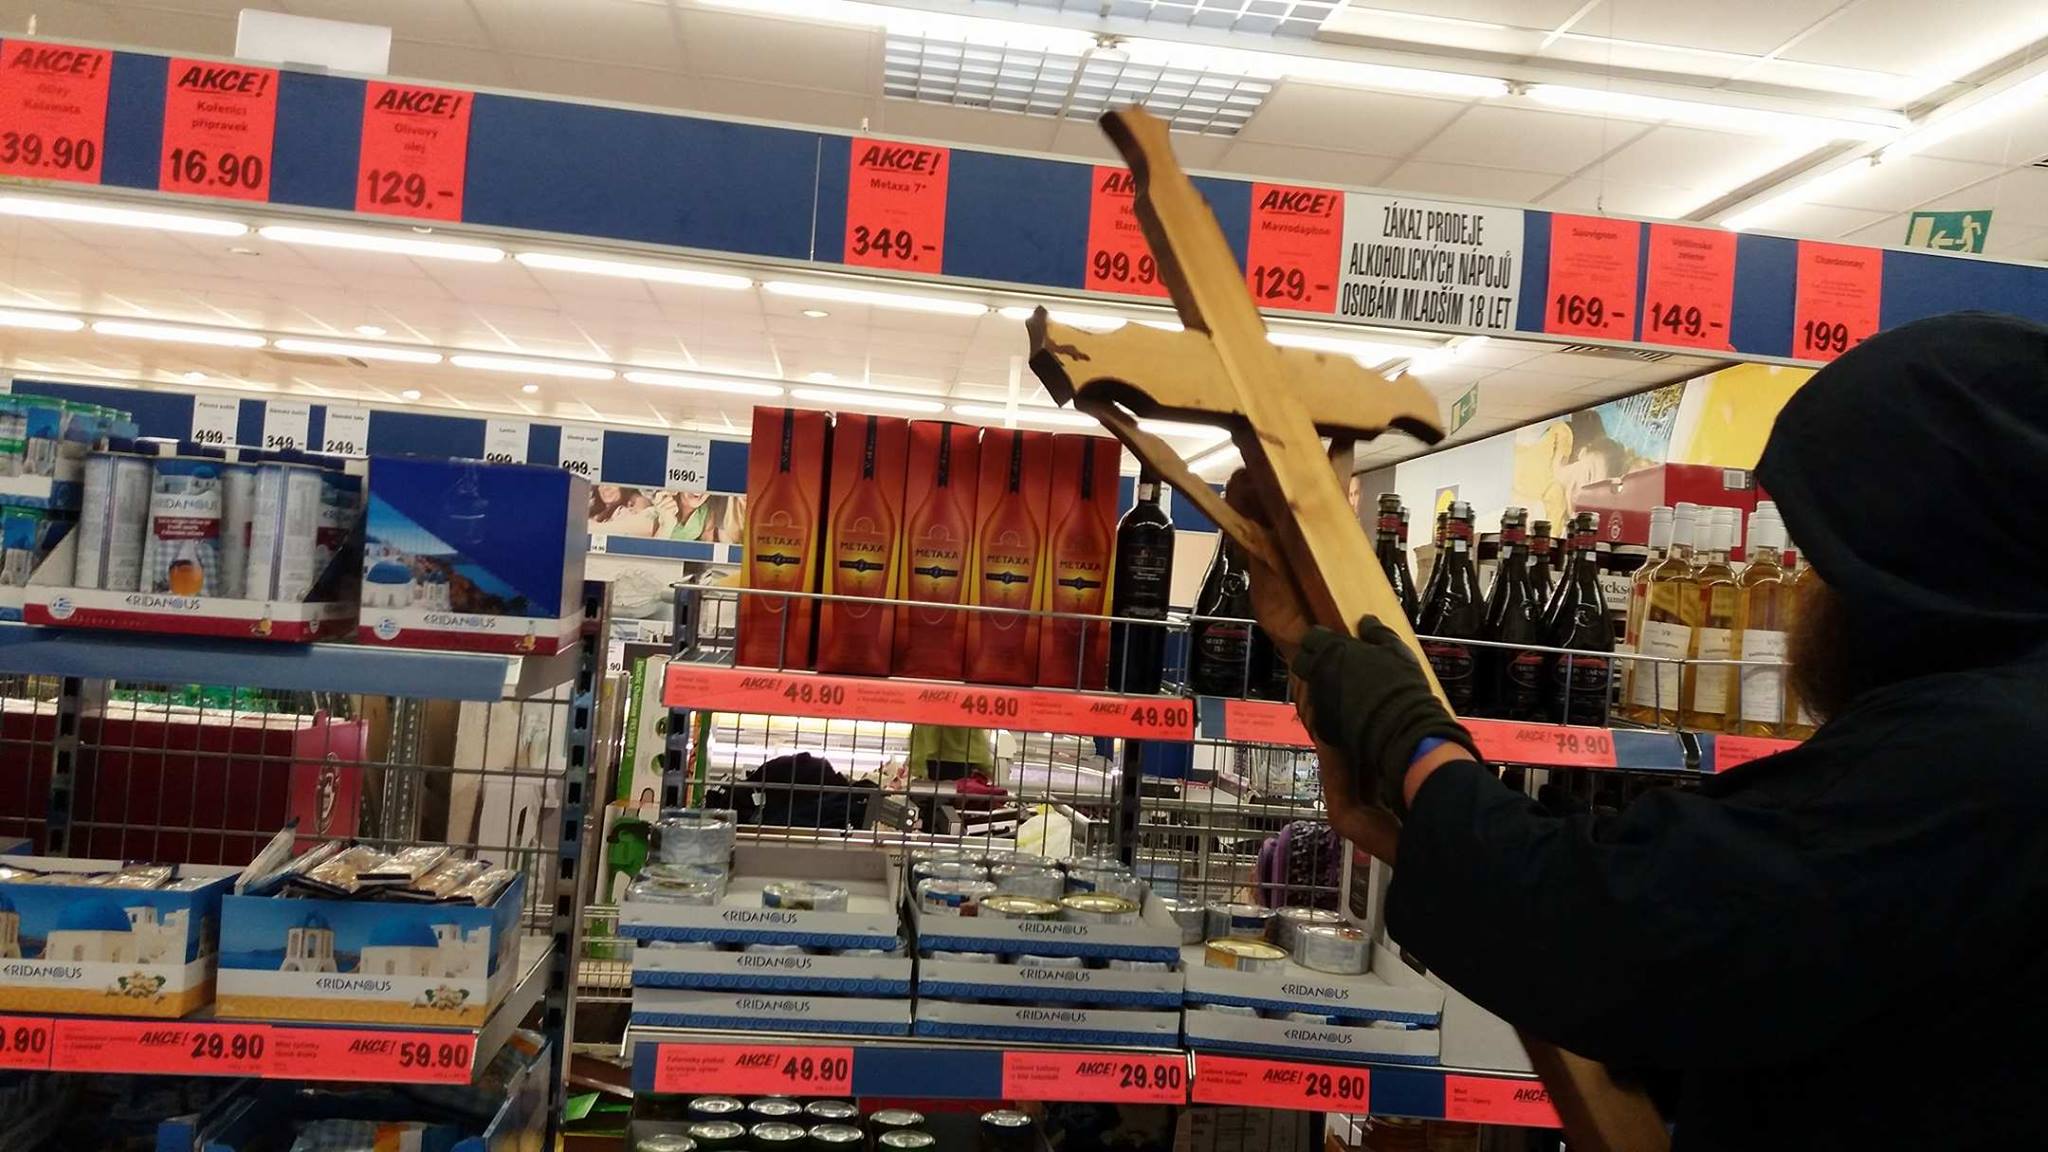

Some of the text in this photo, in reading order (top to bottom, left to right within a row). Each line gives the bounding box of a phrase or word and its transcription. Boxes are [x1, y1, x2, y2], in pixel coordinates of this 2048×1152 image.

[8, 47, 103, 79] AKCE!
[177, 66, 269, 98] AKCE!
[374, 89, 463, 120] AKCE!
[0, 131, 95, 172] 39.90
[859, 145, 941, 176] AKCE!
[170, 148, 263, 190] 16.90
[367, 169, 454, 209] 129.-
[869, 178, 910, 192] Metaxa
[1259, 190, 1337, 218] AKCE!
[1383, 201, 1484, 246] ZÁKAZ PRODEJE
[852, 225, 936, 261] 349.-
[1093, 250, 1168, 287] 99.9
[1349, 243, 1512, 290] ALKOHOLICKÝCH NÁPOJŮ
[1254, 265, 1330, 302] 129.-
[1342, 280, 1513, 329] OSOBÁM MLADŠÍM 18 LET
[1556, 293, 1626, 328] 169.-
[1651, 301, 1724, 338] 149.-
[668, 469, 705, 483] 1690.-
[757, 535, 801, 547] METAXA
[840, 541, 884, 552] METAXA
[916, 548, 960, 560] METAXA
[987, 554, 1030, 565] METAXA
[1059, 560, 1102, 571] METAXA
[423, 614, 496, 628] ERIDANOUS
[740, 676, 782, 691] AKCE!
[783, 682, 844, 705] 49.90
[918, 687, 958, 704] AKCE!
[960, 694, 1018, 717] 49.90
[1089, 701, 1128, 716] AKCE!
[1130, 707, 1188, 728] 49.90
[722, 911, 797, 925] ERIDANOUS
[1018, 923, 1088, 935] ERIDANOUS
[3, 965, 82, 979] ERIDANOUS
[737, 956, 812, 969] ERIDANOUS
[1019, 969, 1090, 982] ERIDANOUS
[316, 978, 392, 993] ERIDANOUS
[1281, 984, 1349, 1000] ERIDANOUS
[736, 999, 810, 1012] ERIDANOUS
[1016, 1010, 1087, 1023] ERIDANOUS
[139, 1031, 189, 1046] AKCE!
[191, 1031, 265, 1060] 29.90
[1284, 1030, 1352, 1044] ERIDANOUS
[348, 1039, 468, 1068] AKCE! 59.90
[736, 1053, 781, 1069] AKCE!
[782, 1056, 848, 1081] 49.90
[1076, 1062, 1117, 1077] AKCE!
[1120, 1063, 1181, 1089] 29.90
[1262, 1068, 1304, 1085] AKCE!
[1304, 1072, 1365, 1100] 29.90
